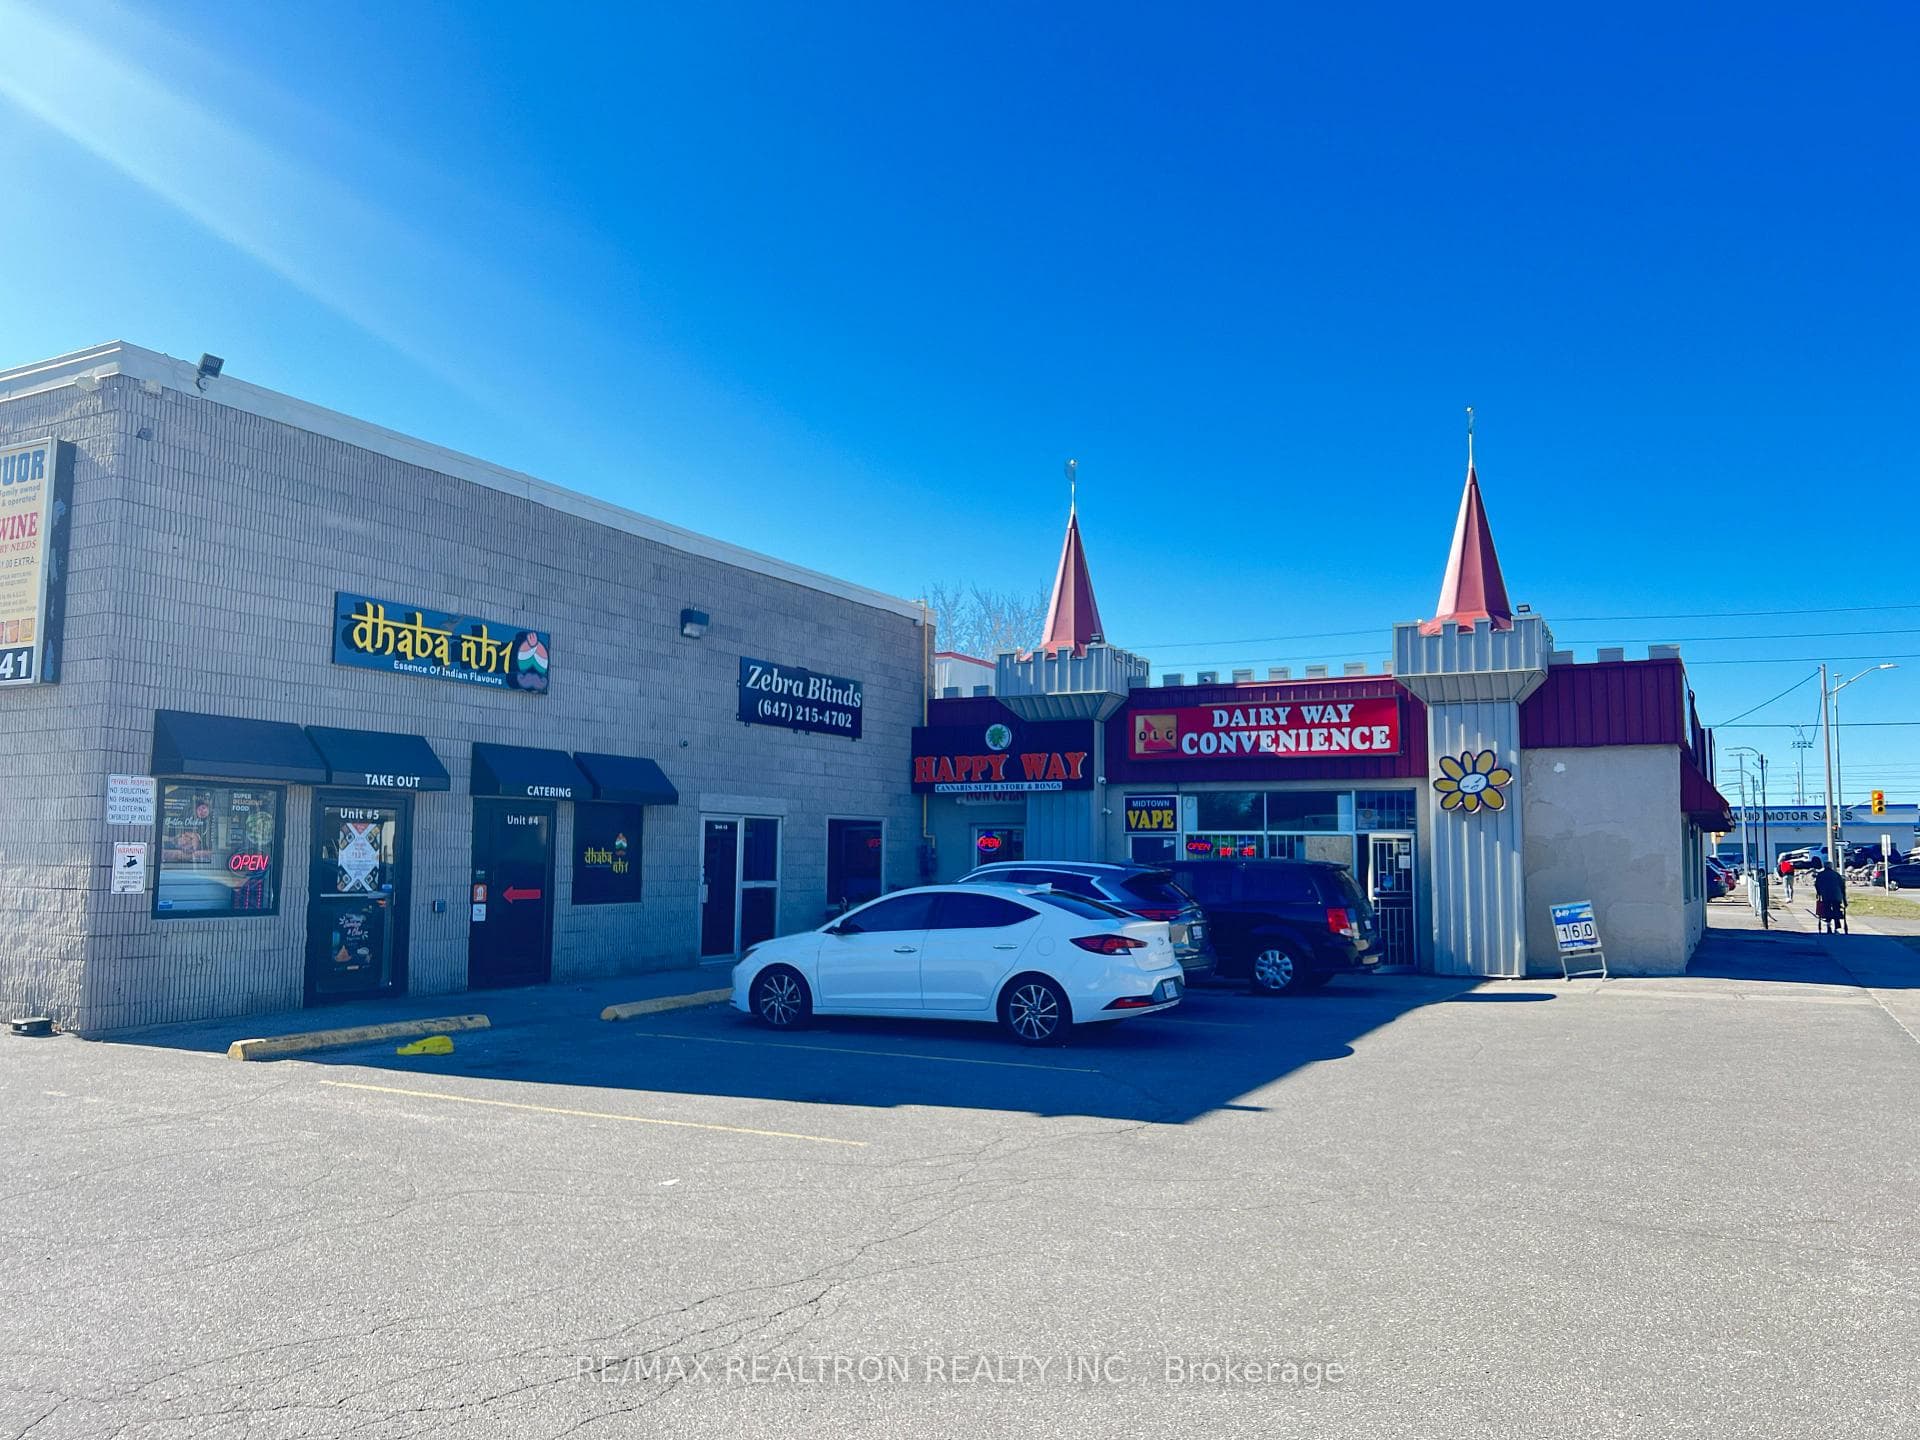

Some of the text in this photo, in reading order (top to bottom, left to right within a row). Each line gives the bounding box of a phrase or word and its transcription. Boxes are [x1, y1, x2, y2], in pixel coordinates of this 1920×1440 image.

[0, 449, 45, 485] UOR
[352, 601, 453, 667] dhaba
[393, 660, 503, 686] Essence Of Indian Flavours
[746, 665, 862, 708] Zebra Blinds
[758, 699, 852, 728] (647) 215-4702
[1212, 704, 1354, 727] DAIRY WAY
[1181, 726, 1391, 755] CONVENIENCE
[914, 751, 1087, 783] HAPPY WAY
[365, 773, 420, 788] TAKE OUT
[936, 783, 973, 792] CANNABIS
[974, 783, 999, 792] SUPER
[1000, 782, 1025, 791] STORE
[527, 785, 572, 798] CATERING
[1132, 800, 1171, 808] MIDTOWN
[340, 808, 380, 820] Unit #5
[507, 815, 539, 825] Unit #4
[1127, 809, 1176, 830] VAPE
[1765, 811, 1808, 820] MOTOR
[1813, 811, 1853, 820] SAS
[1187, 842, 1211, 851] OPEN
[230, 854, 269, 871] OPEN
[584, 847, 612, 864] dhaba
